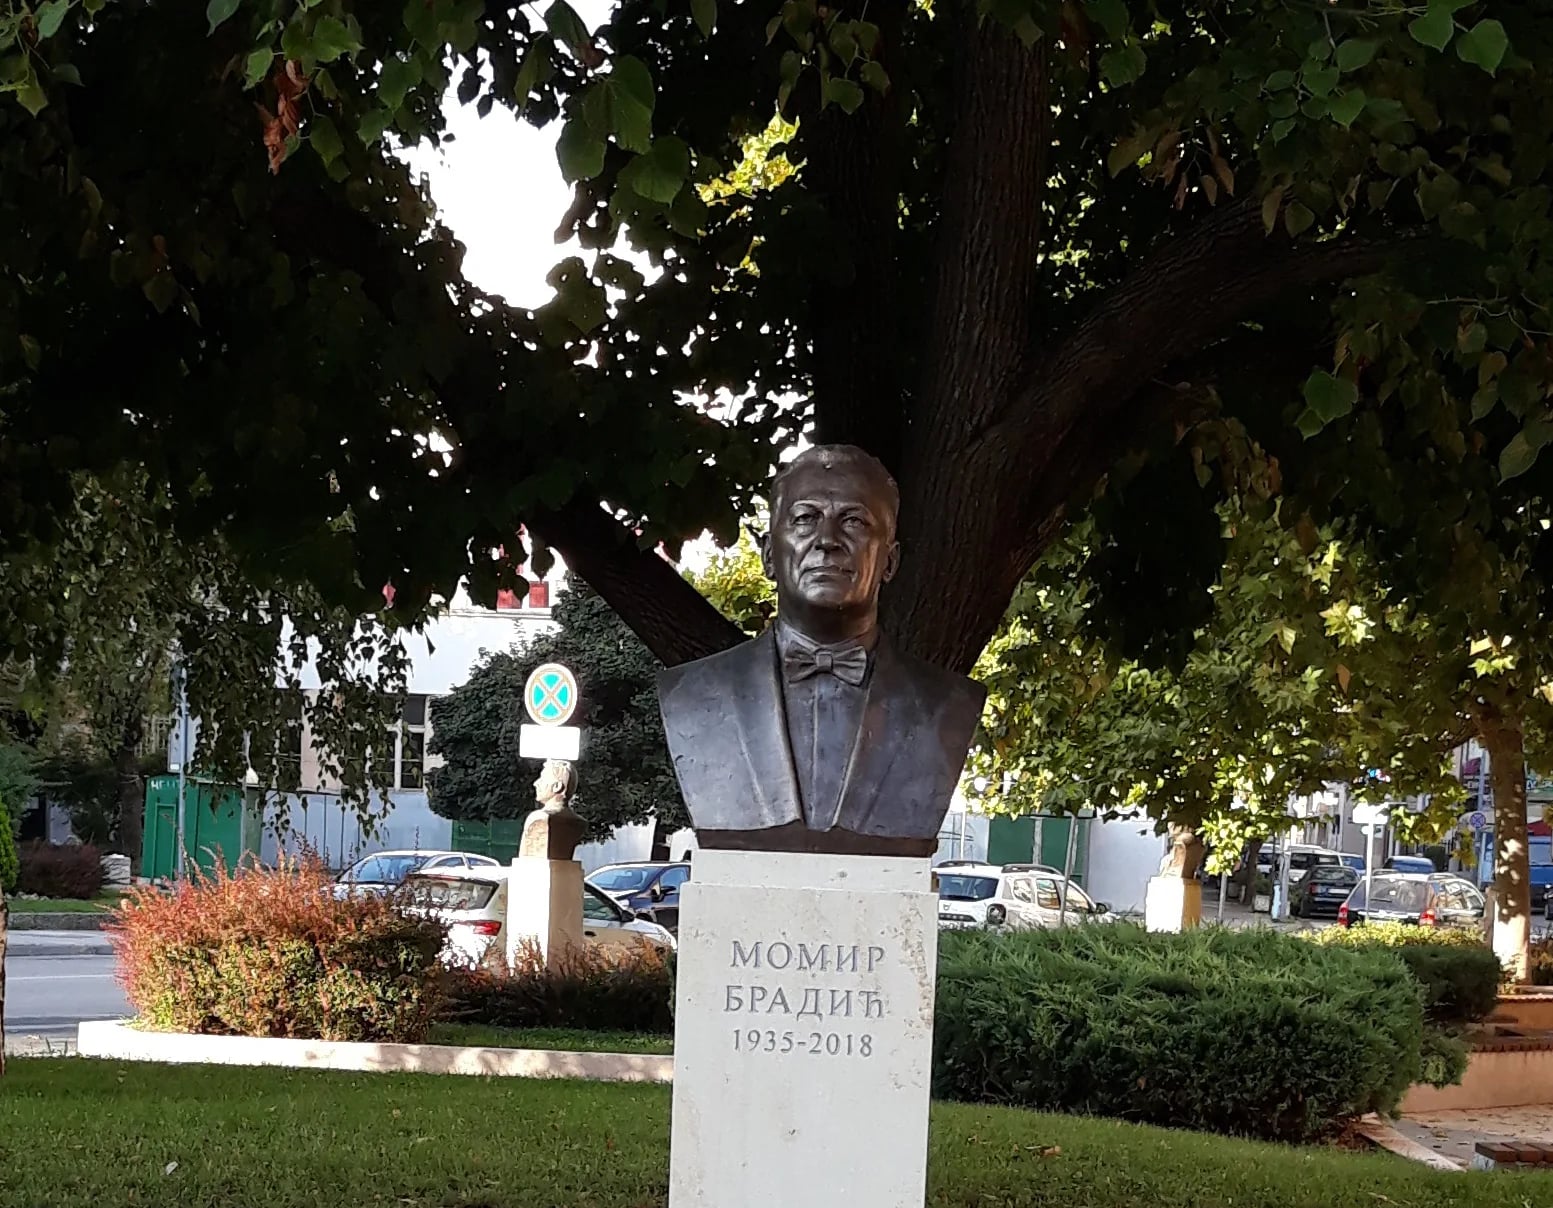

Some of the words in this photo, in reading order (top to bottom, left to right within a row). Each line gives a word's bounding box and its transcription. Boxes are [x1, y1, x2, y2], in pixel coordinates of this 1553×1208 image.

[730, 940, 885, 973] МОМИР
[723, 984, 885, 1022] БРАДИЋ
[733, 1028, 873, 1057] 1935-2018
